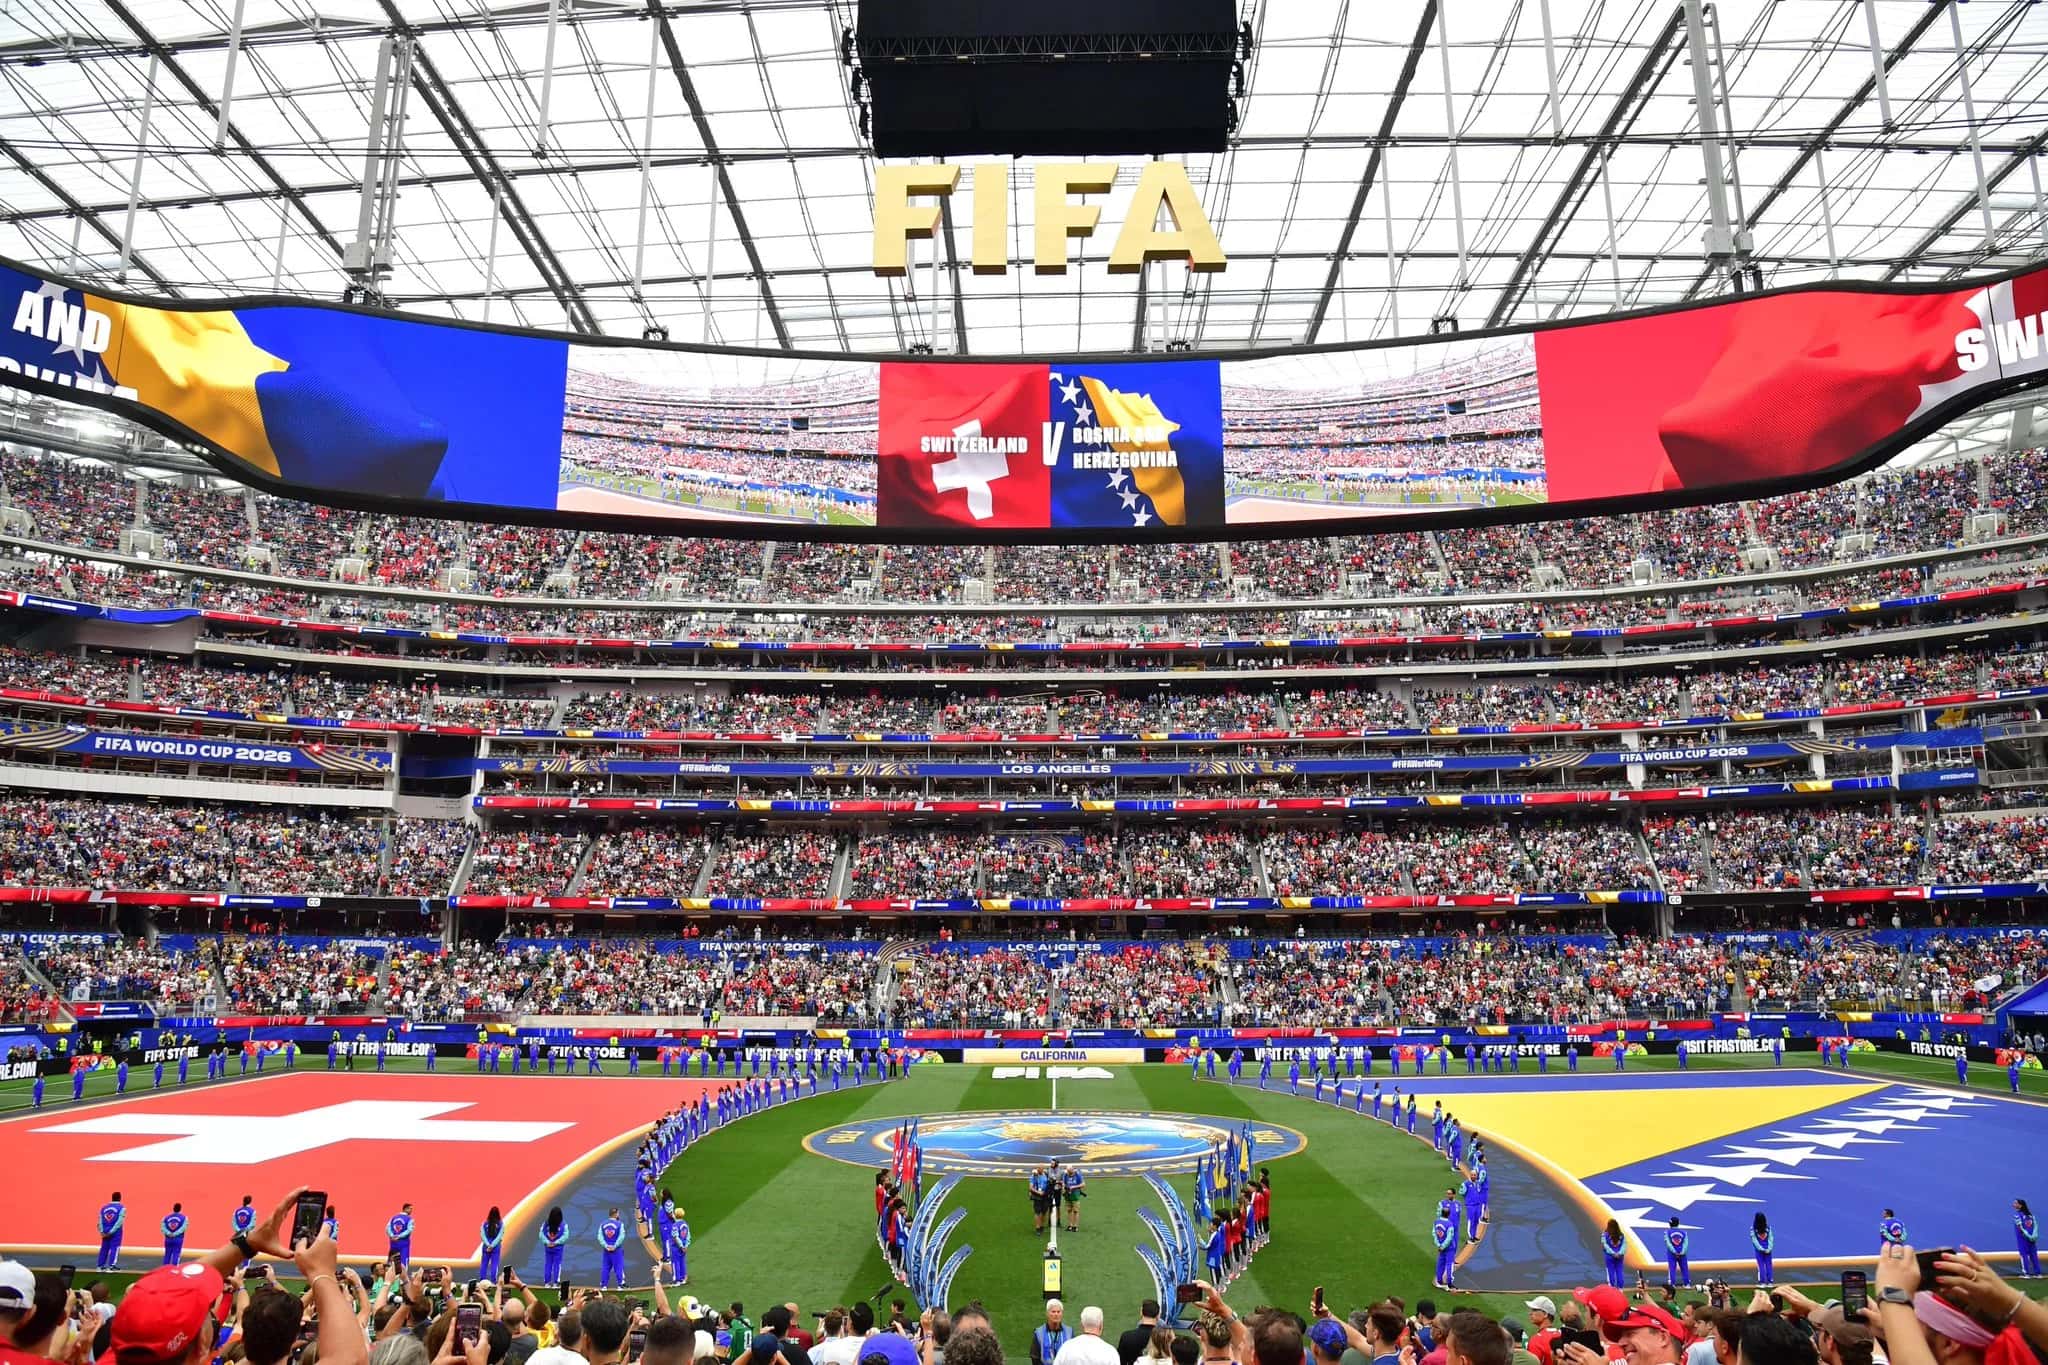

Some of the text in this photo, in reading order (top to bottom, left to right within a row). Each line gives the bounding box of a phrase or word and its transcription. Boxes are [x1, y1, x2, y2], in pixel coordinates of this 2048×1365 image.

[872, 161, 1227, 276] FIFA
[13, 290, 112, 353] AND
[1073, 426, 1130, 444] BOSNIA
[921, 436, 1028, 453] SWITZERLAND
[1042, 421, 1065, 466] V
[1073, 450, 1178, 469] HERZEGOVINA
[95, 736, 292, 763] FIFA WORLD CUP 2026
[1620, 746, 1748, 763] FIFA WORLD CUP 2026
[1002, 765, 1111, 774] LOS ANGELES
[1392, 759, 1443, 769] #FIFAWorldCup
[699, 943, 721, 951] FIFA
[1008, 943, 1034, 952] LOS
[522, 1037, 546, 1045] FIFA
[1568, 1035, 1591, 1043] FIFA
[1020, 1051, 1087, 1060] CALIFORNIA
[1911, 1042, 1933, 1055] FIFA
[145, 1049, 166, 1063] FIFA
